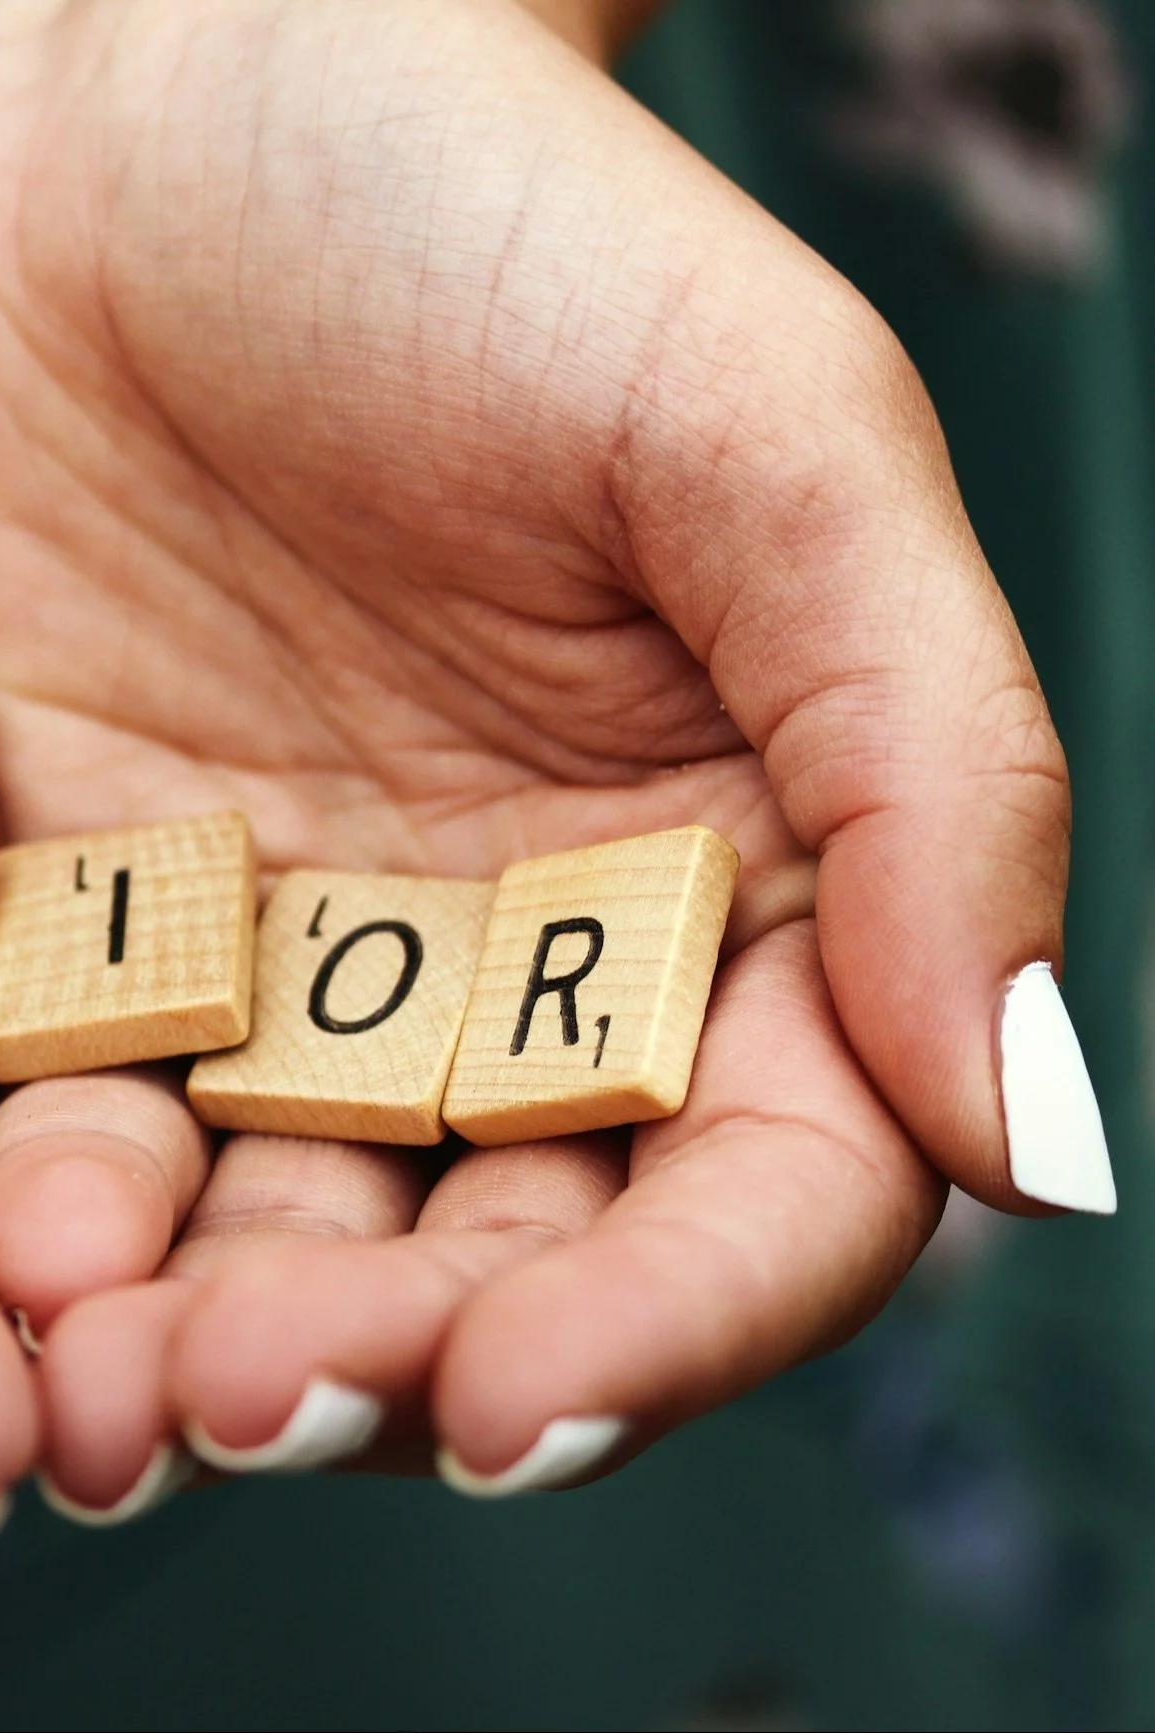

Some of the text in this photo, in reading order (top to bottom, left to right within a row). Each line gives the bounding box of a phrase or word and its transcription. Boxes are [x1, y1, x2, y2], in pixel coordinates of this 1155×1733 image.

[75, 857, 88, 892] 1
[306, 896, 329, 938] 1
[592, 1014, 612, 1069] 1
